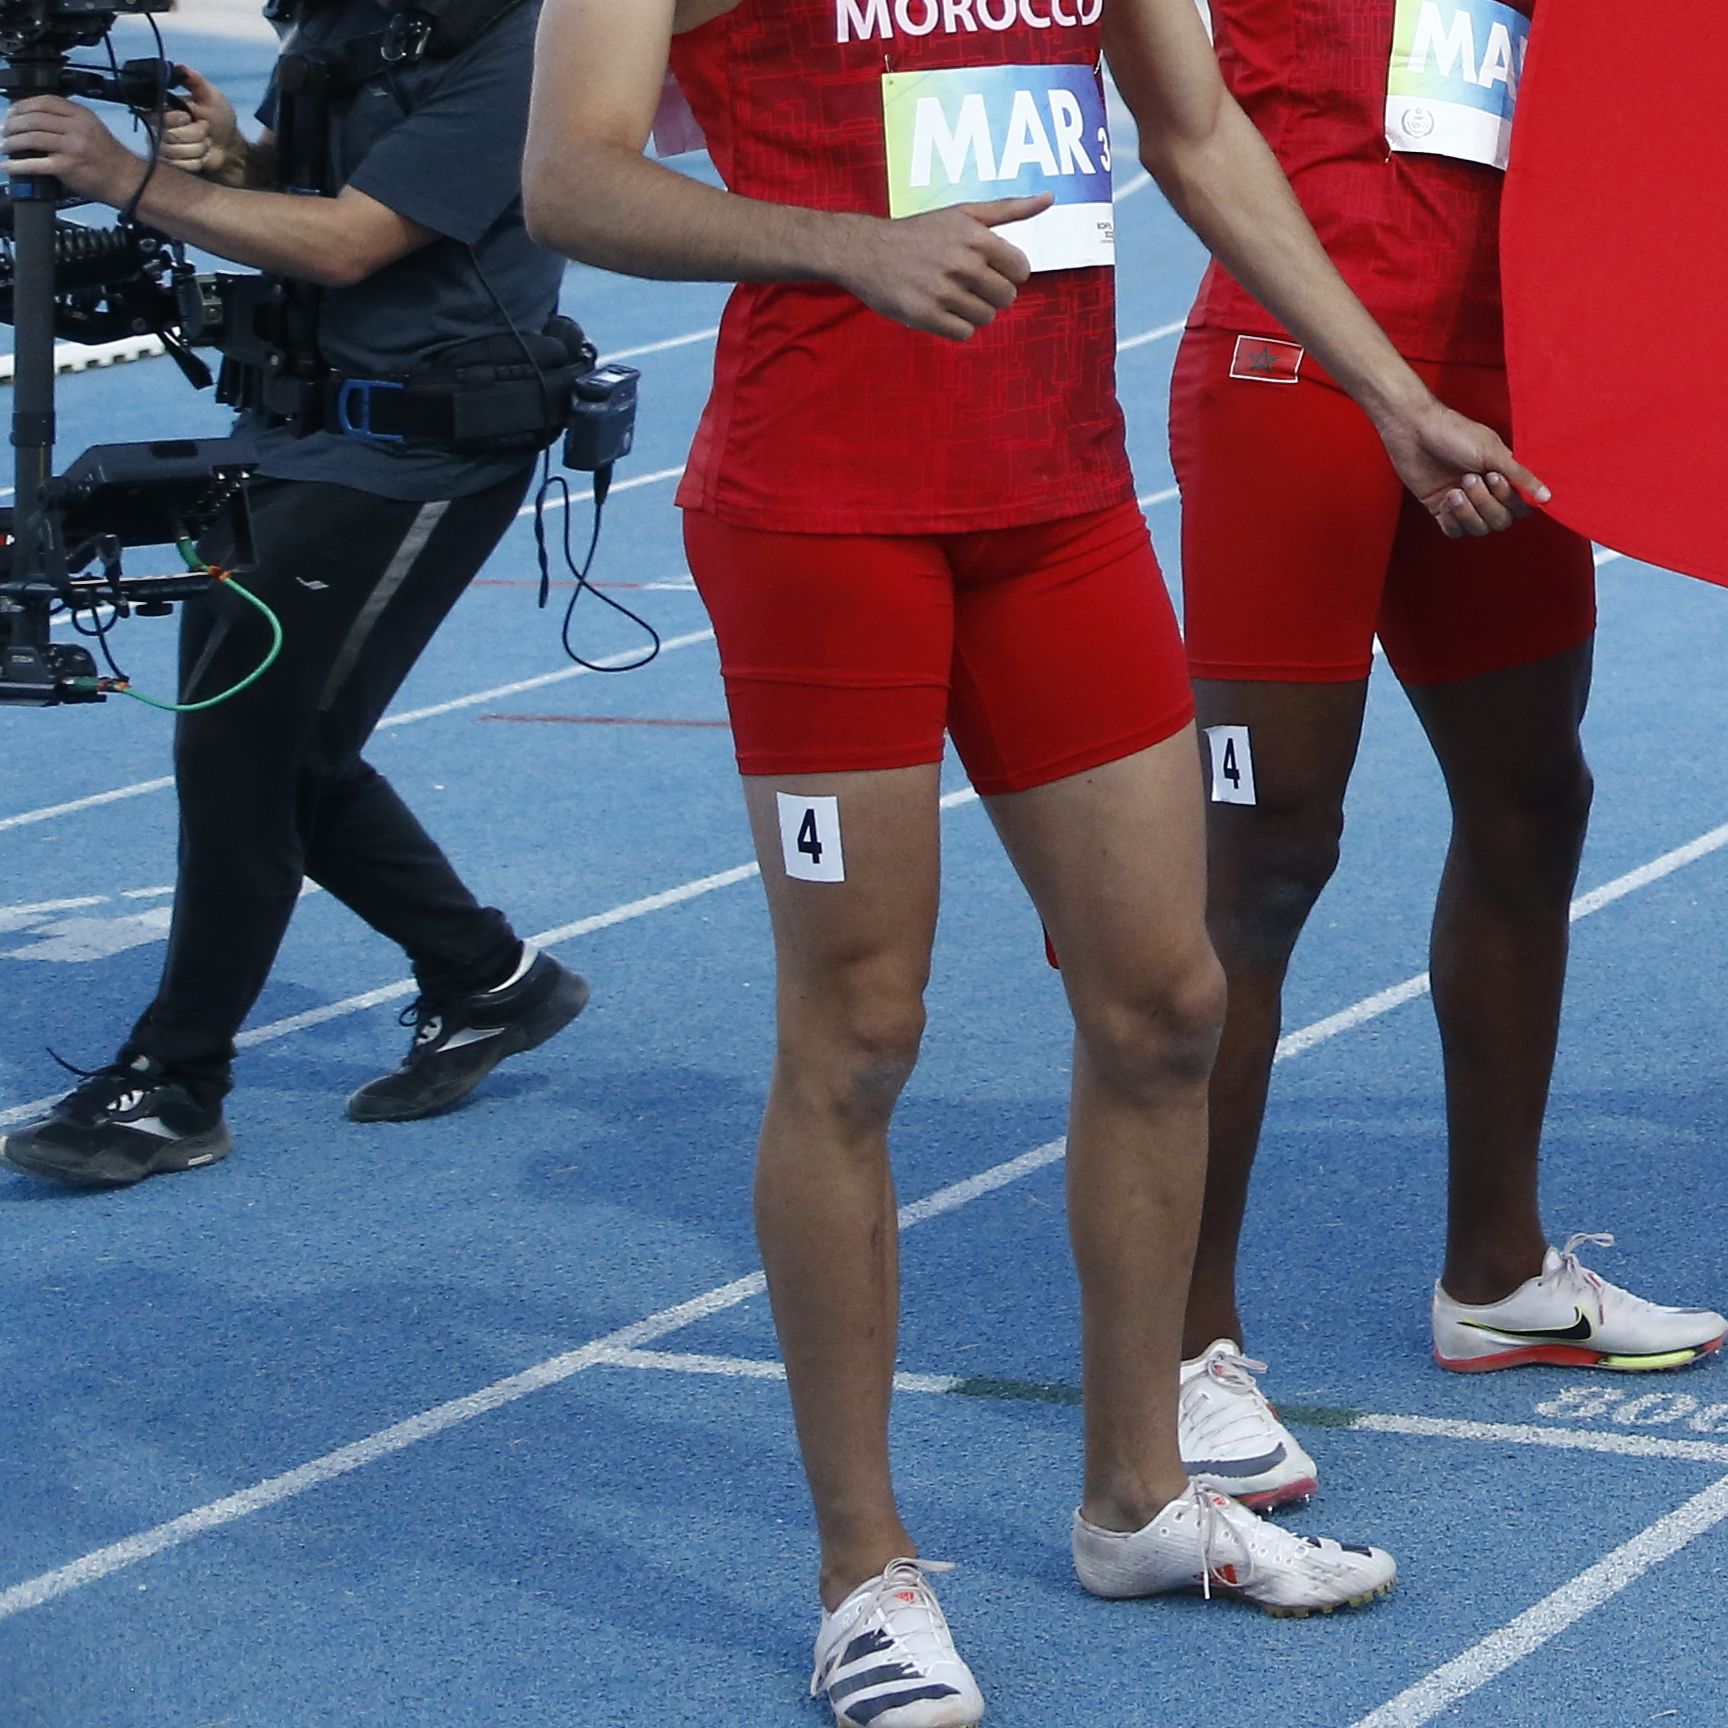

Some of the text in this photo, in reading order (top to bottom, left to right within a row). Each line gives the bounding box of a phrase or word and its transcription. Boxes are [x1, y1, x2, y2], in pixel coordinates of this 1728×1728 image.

[909, 88, 1097, 189] MAR
[1222, 737, 1241, 790] 4
[797, 808, 823, 865] 4
